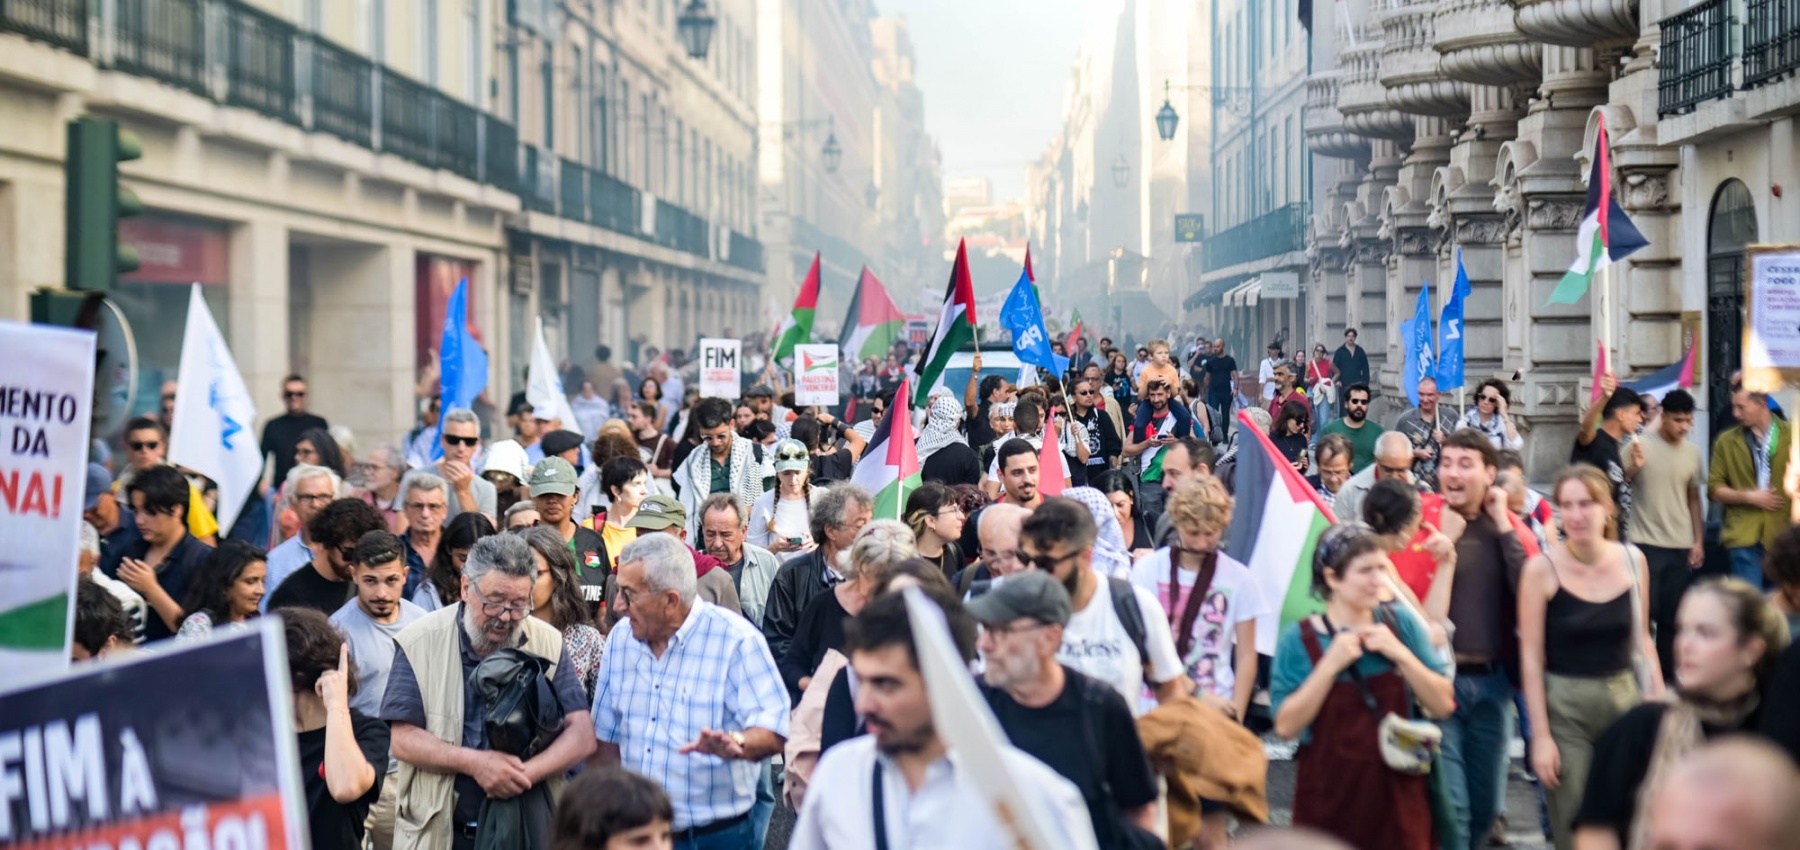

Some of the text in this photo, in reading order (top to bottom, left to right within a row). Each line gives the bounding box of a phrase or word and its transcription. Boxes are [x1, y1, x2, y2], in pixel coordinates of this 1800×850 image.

[706, 347, 735, 368] FIM
[11, 425, 50, 459] DA
[0, 711, 107, 841] FIM
[119, 726, 159, 815] À
